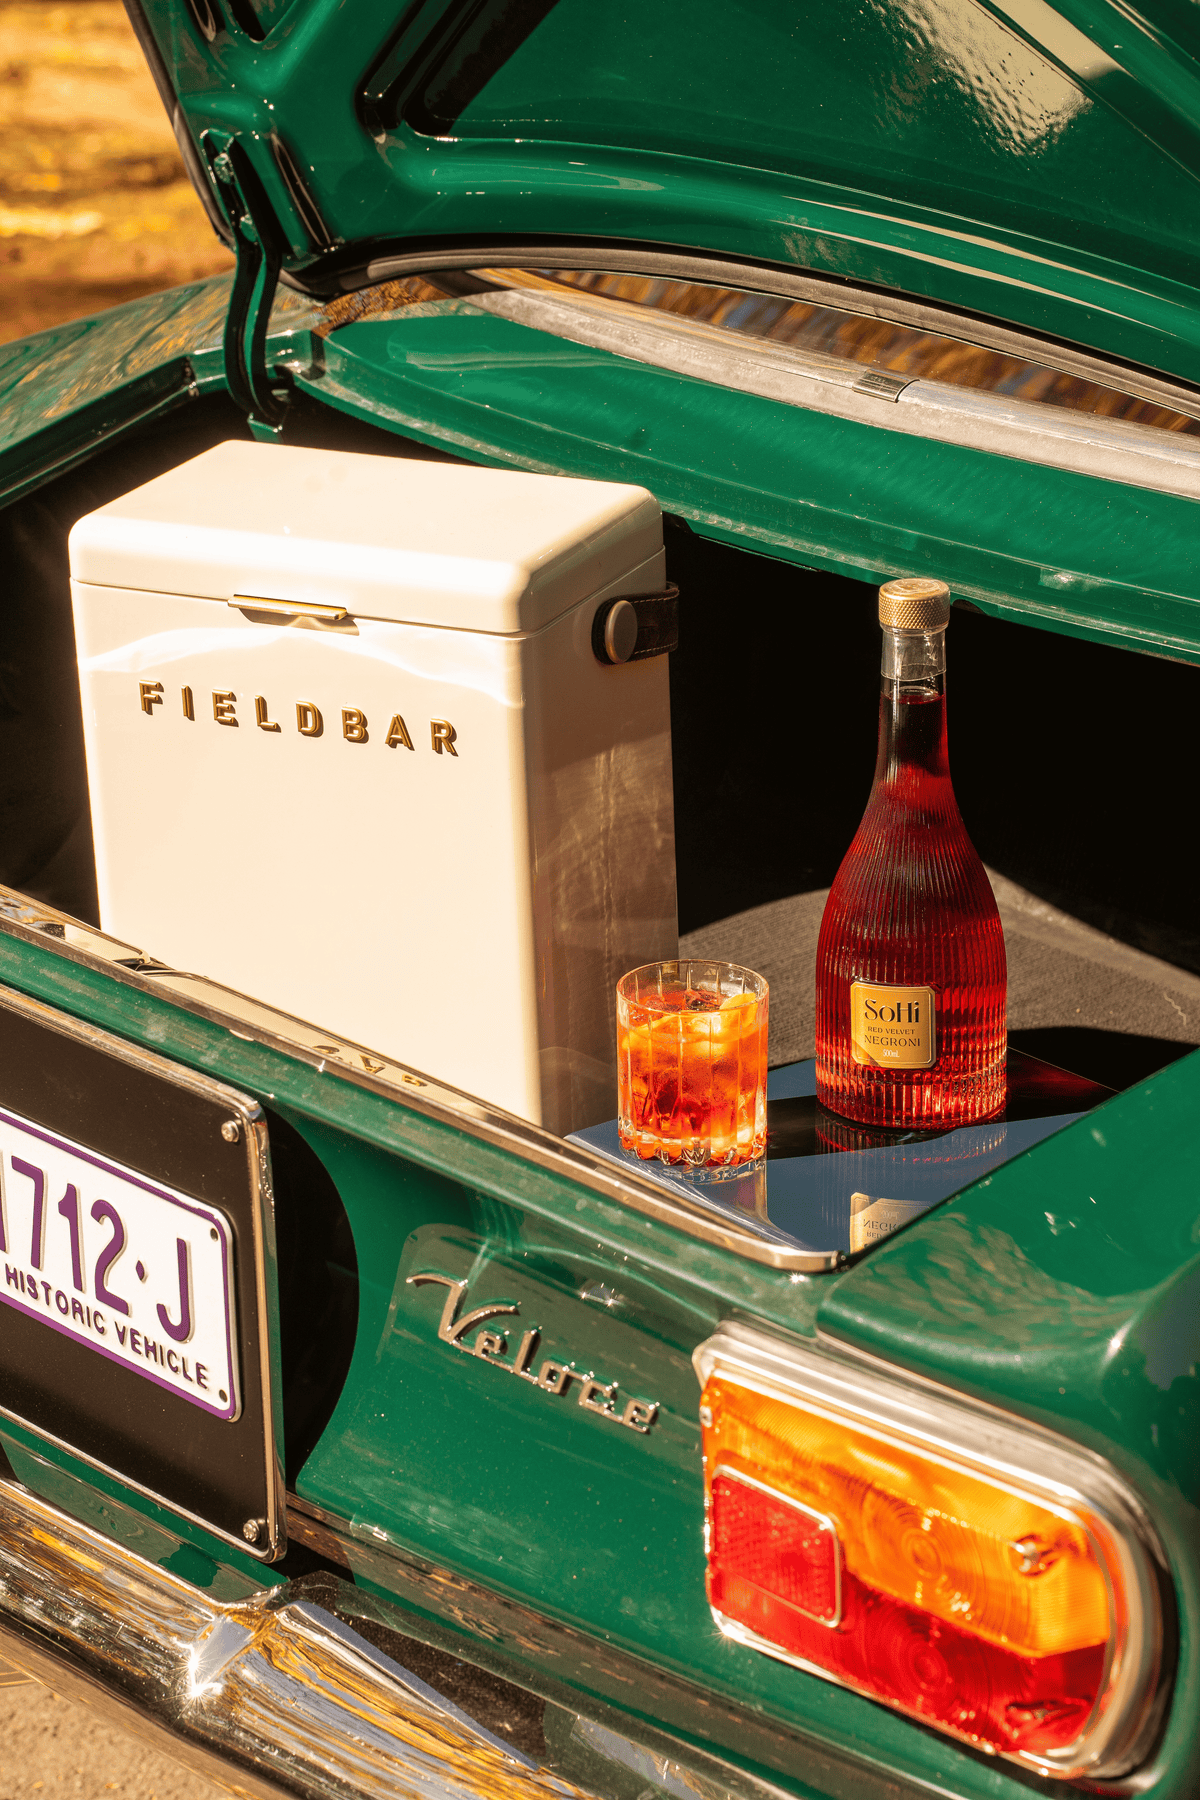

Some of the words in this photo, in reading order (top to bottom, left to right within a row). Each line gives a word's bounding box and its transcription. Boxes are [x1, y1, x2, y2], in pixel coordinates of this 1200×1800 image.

[139, 679, 459, 757] FIELDBAR
[864, 998, 920, 1023] SoHi
[864, 1034, 920, 1047] NEGRONI
[867, 1026, 883, 1034] RED
[0, 1154, 191, 1343] 712·J
[4, 1262, 106, 1335] HISTORIC
[114, 1320, 209, 1390] VEHICLE
[405, 1270, 660, 1435] Veloce
